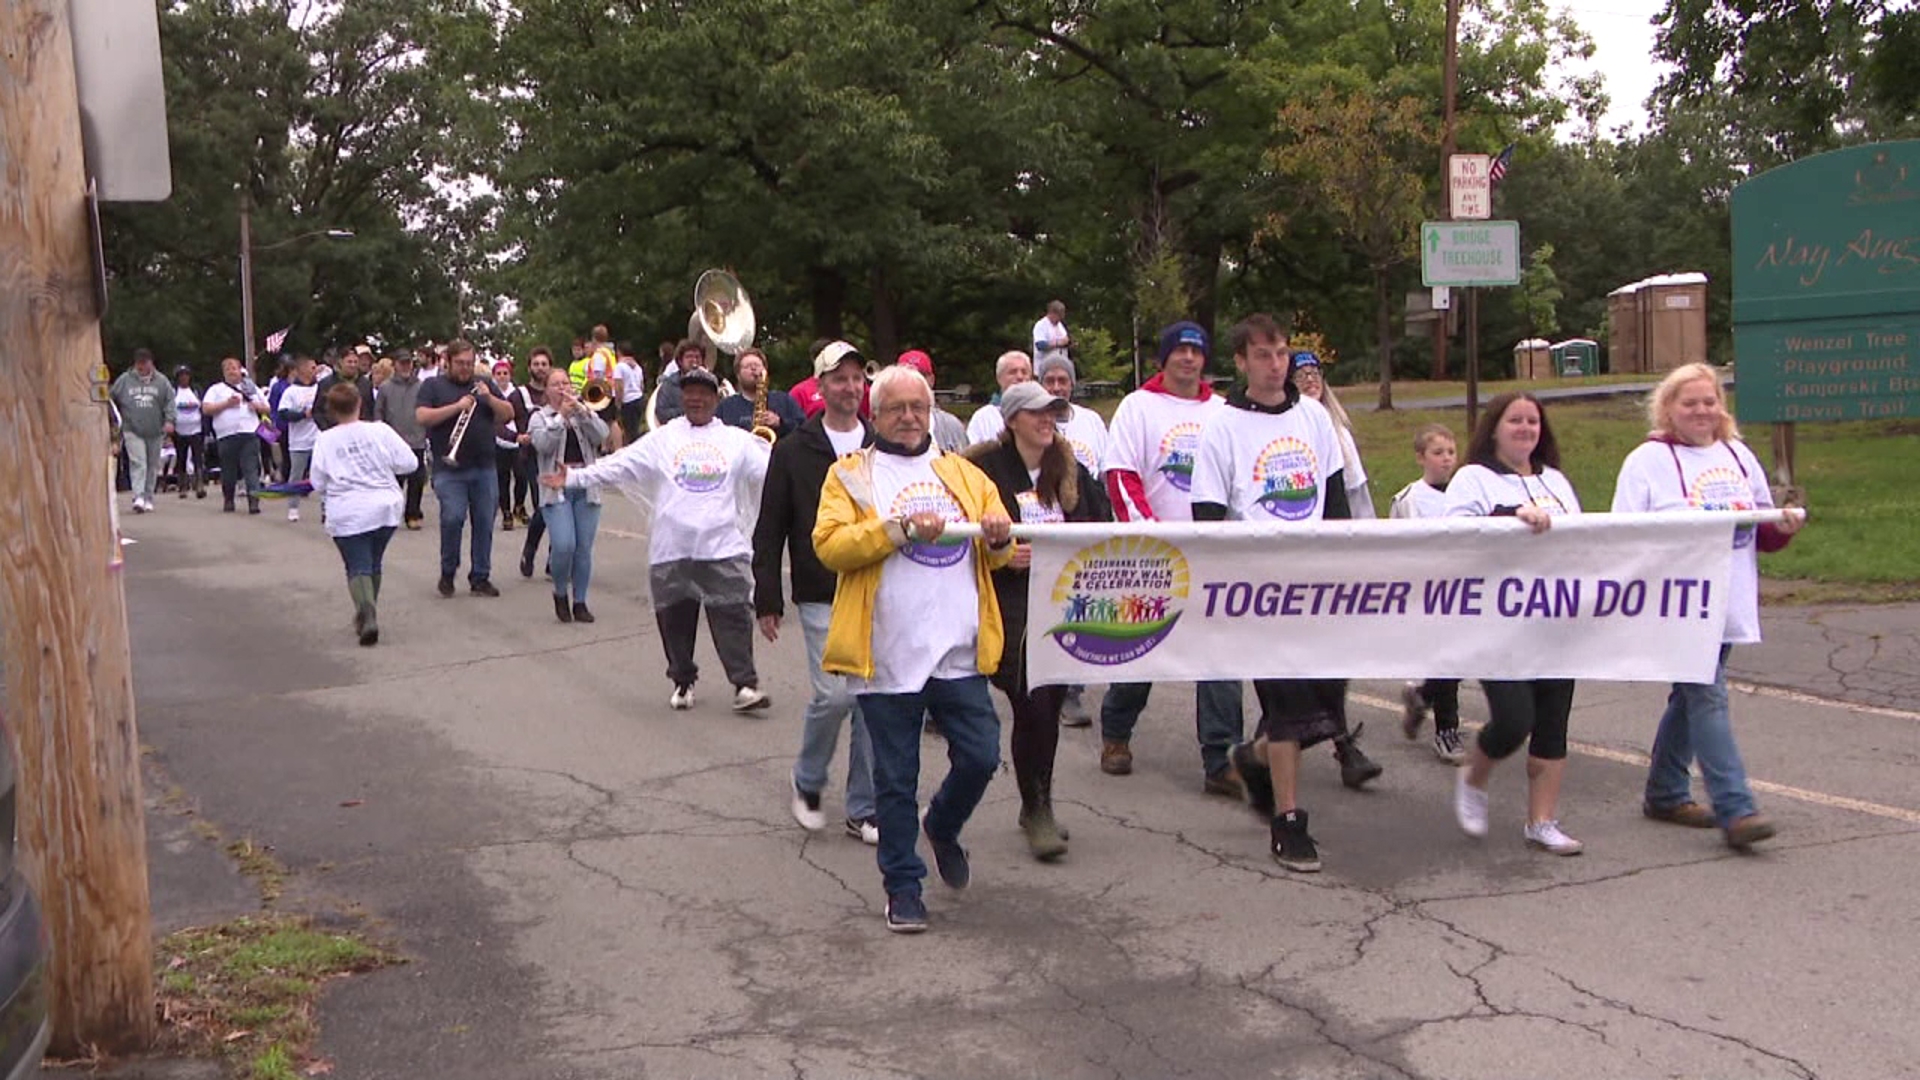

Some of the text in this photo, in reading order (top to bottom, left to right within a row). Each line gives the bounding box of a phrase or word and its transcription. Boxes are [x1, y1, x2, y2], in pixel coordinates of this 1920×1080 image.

[1462, 161, 1477, 175] NO
[1453, 176, 1486, 189] PARKING
[1463, 193, 1477, 202] ANY
[1452, 229, 1491, 245] BRIDGE
[1442, 248, 1504, 265] TREEHOUSE
[1784, 331, 1908, 351] Wenzel Tree
[1785, 353, 1909, 375] Playground
[1784, 379, 1878, 397] Kanjorski
[1858, 399, 1906, 416] Trail
[1139, 558, 1170, 568] COUNTY
[1074, 569, 1173, 581] RECOVERY WALK
[1072, 579, 1172, 591] & CELEBRATION
[1203, 577, 1711, 619] TOGETHER WE CAN DO IT!
